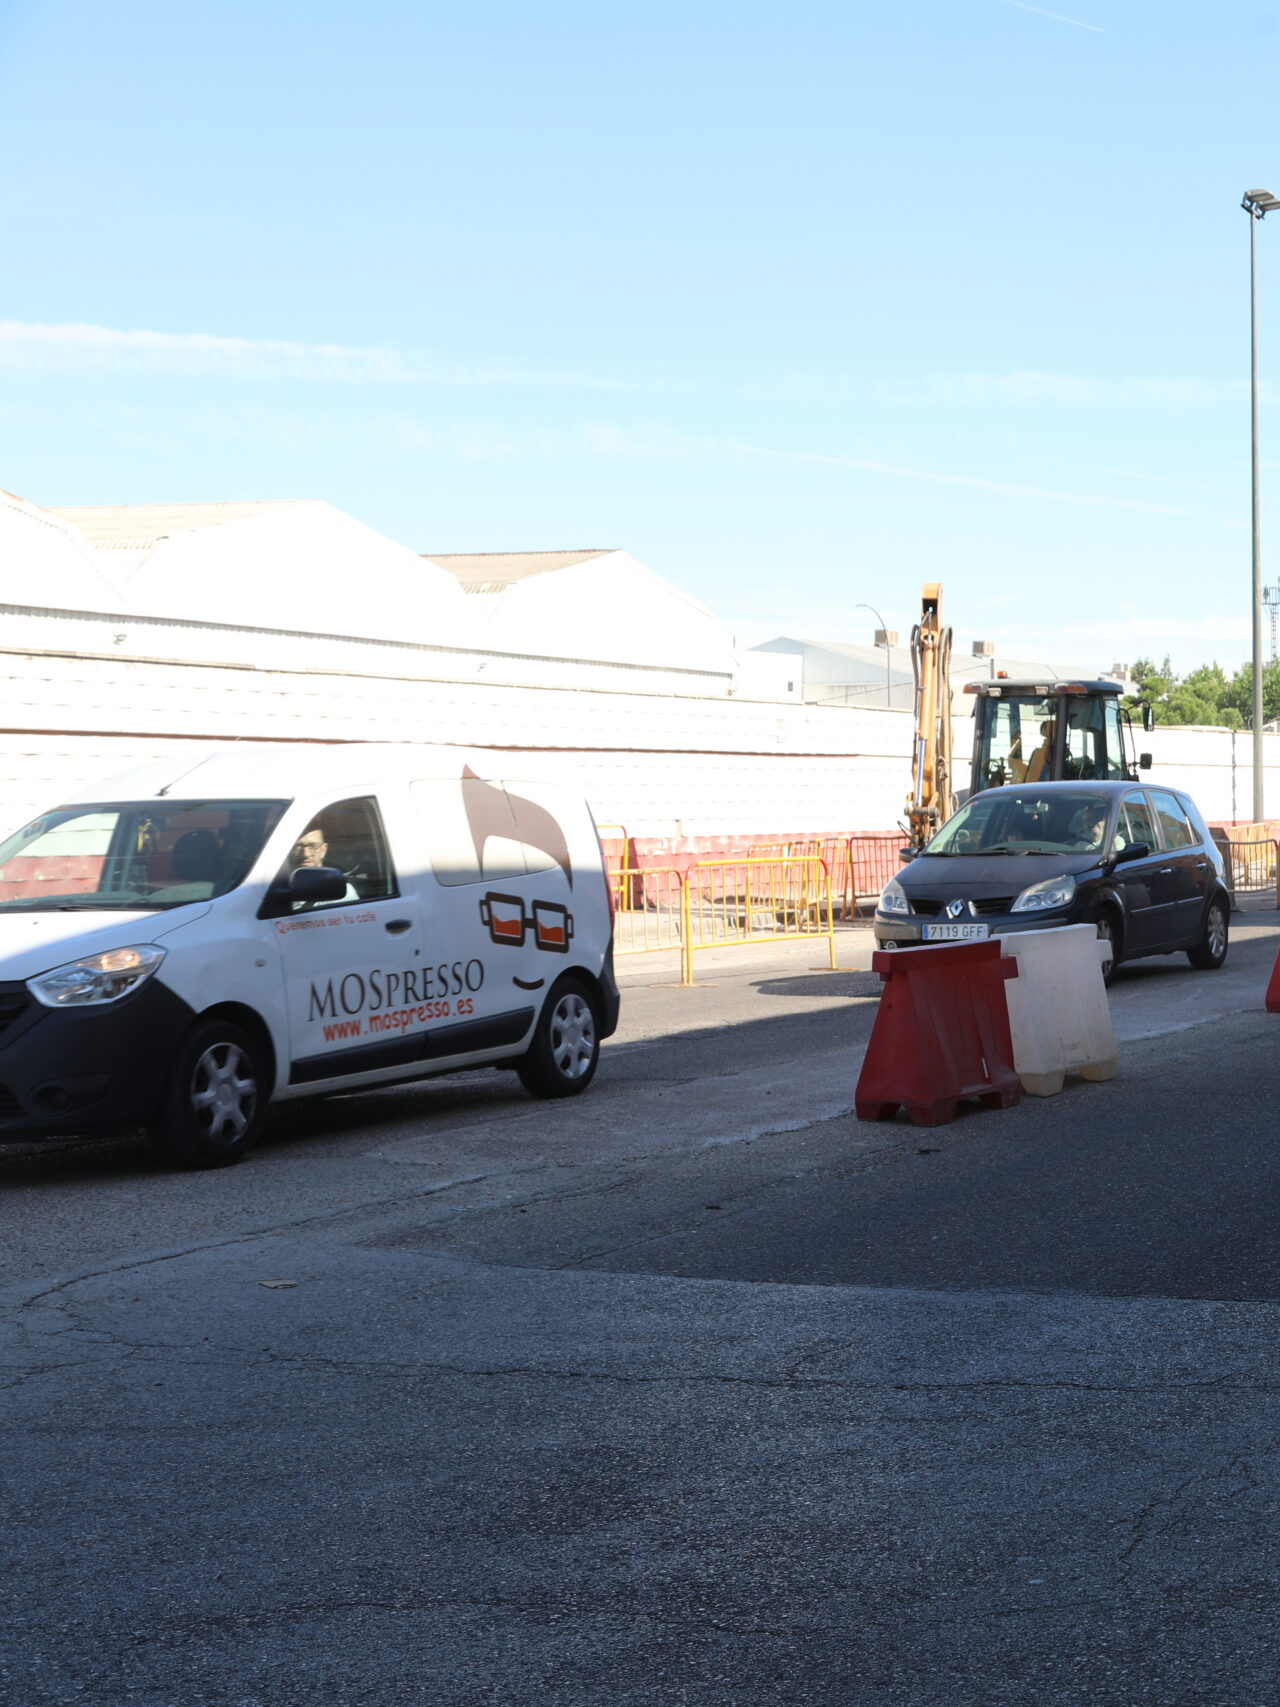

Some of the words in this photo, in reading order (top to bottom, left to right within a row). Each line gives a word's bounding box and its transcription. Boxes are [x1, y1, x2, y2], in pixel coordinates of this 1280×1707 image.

[930, 926, 959, 938] 7119
[962, 926, 984, 938] GFF
[323, 997, 474, 1042] www.mospresso.es
